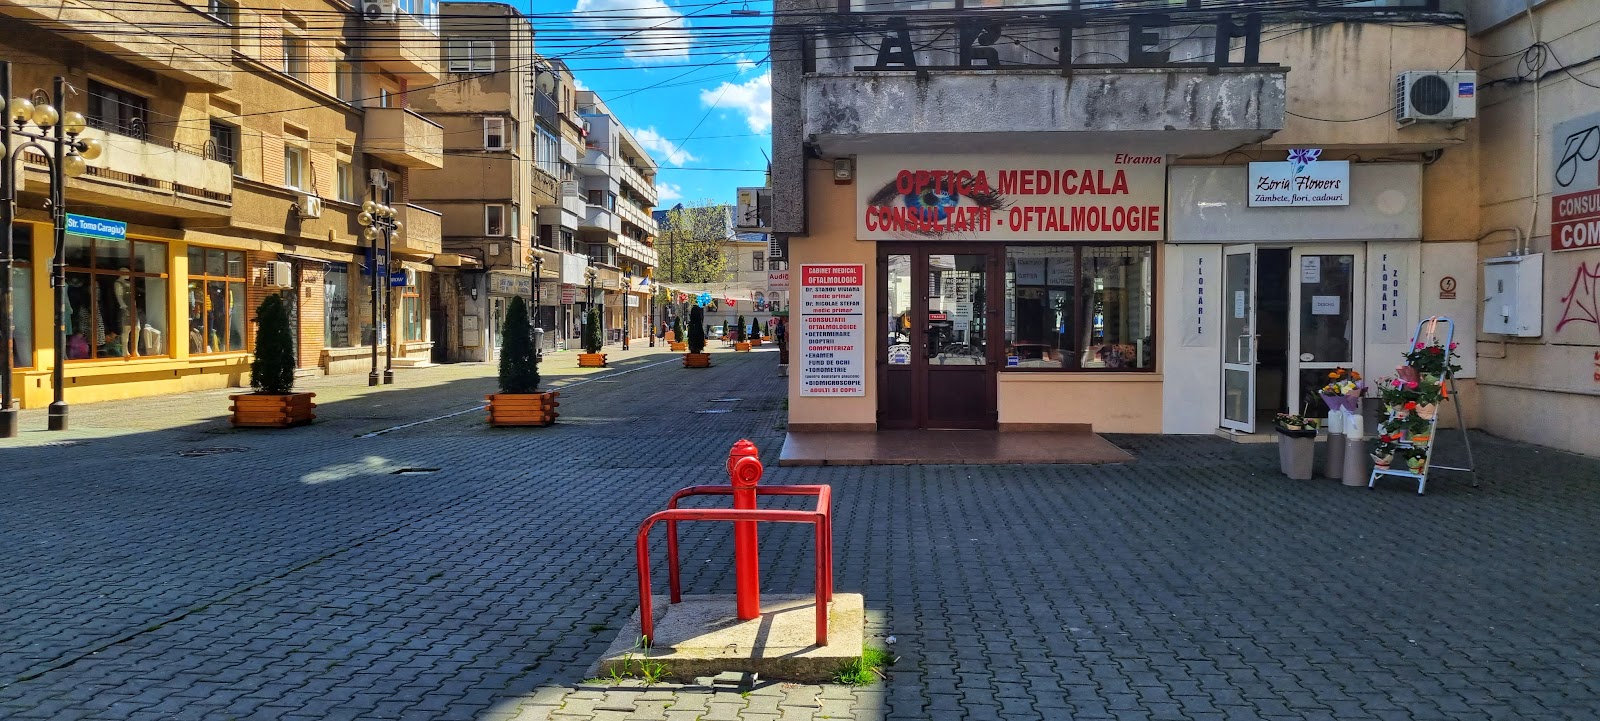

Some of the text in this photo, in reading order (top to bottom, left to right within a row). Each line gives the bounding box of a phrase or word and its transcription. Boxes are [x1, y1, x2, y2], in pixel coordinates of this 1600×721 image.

[875, 12, 1262, 67] ARTEM
[1114, 153, 1162, 164] Elrama
[896, 169, 1129, 195] OPTICA MEDICALA
[1257, 175, 1342, 191] Zoria Flowers
[1312, 193, 1343, 201] cadouri
[68, 218, 121, 235] Str. Toma Caragiu
[865, 205, 991, 232] CONSULTATII
[1009, 205, 1160, 232] OFTALMOLOGIE
[1561, 220, 1600, 248] COM
[808, 276, 857, 284] OFTALMOLOGIC
